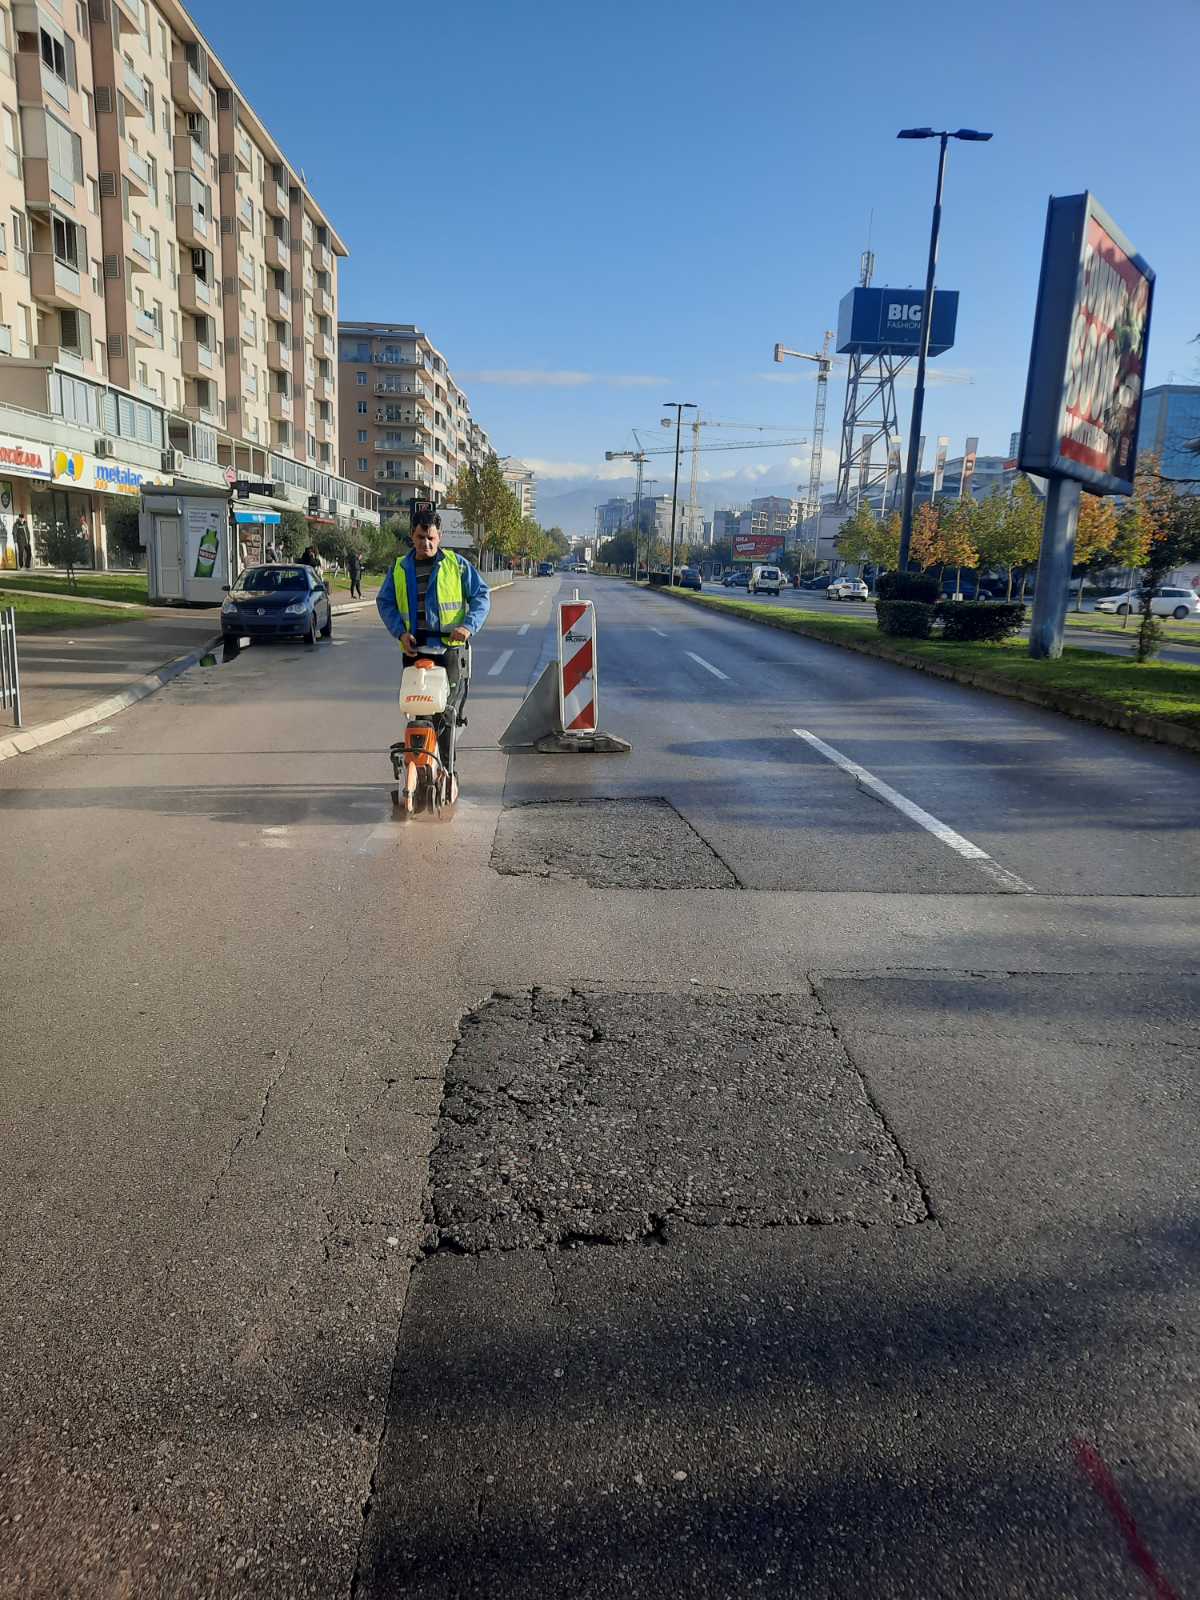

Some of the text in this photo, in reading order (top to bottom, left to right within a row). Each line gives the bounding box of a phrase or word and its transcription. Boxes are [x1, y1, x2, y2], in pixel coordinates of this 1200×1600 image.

[888, 303, 921, 320] BIG
[887, 320, 920, 328] FASHION
[96, 465, 143, 487] metalac
[405, 695, 433, 703] STIHL
